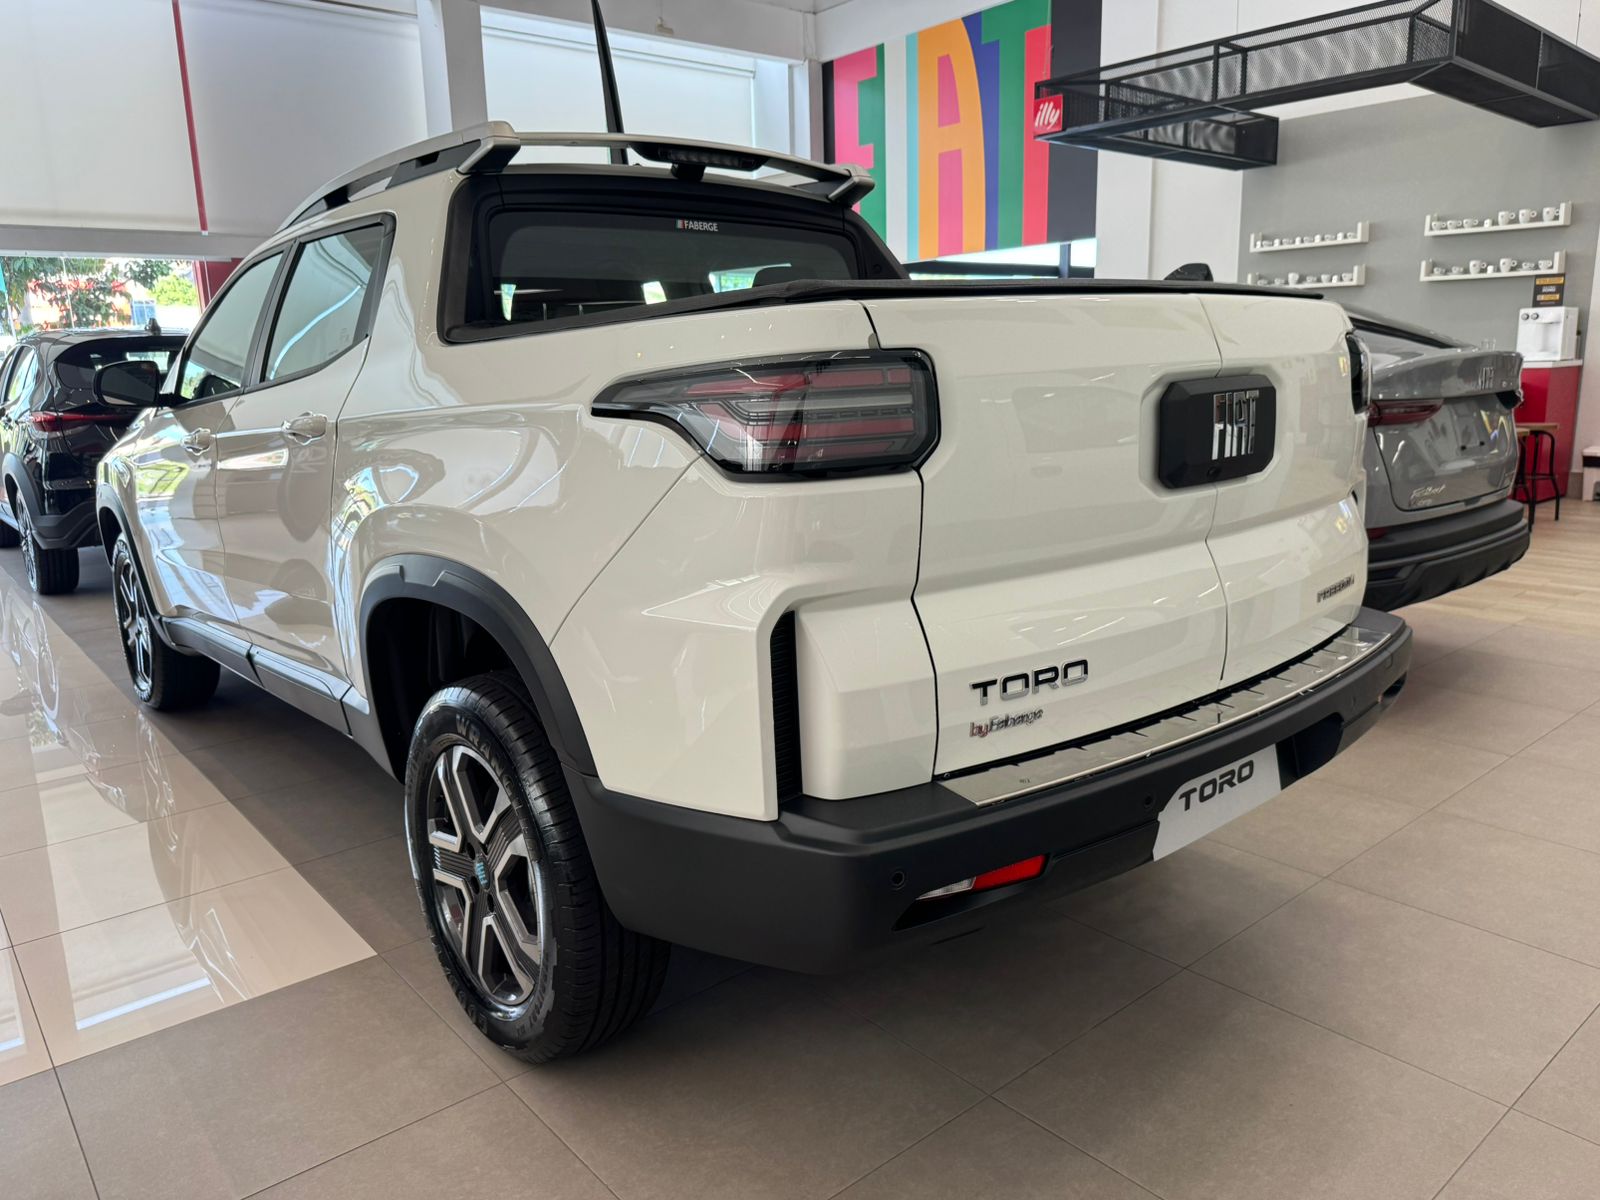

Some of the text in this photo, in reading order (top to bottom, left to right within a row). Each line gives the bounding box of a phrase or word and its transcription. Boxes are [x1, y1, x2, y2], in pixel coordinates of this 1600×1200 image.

[833, 0, 1051, 263] FIAT
[1035, 101, 1060, 130] illy
[684, 219, 719, 232] FABERGE
[1211, 389, 1260, 461] FIAT
[969, 659, 1089, 706] TORO
[1178, 759, 1254, 812] TORO
